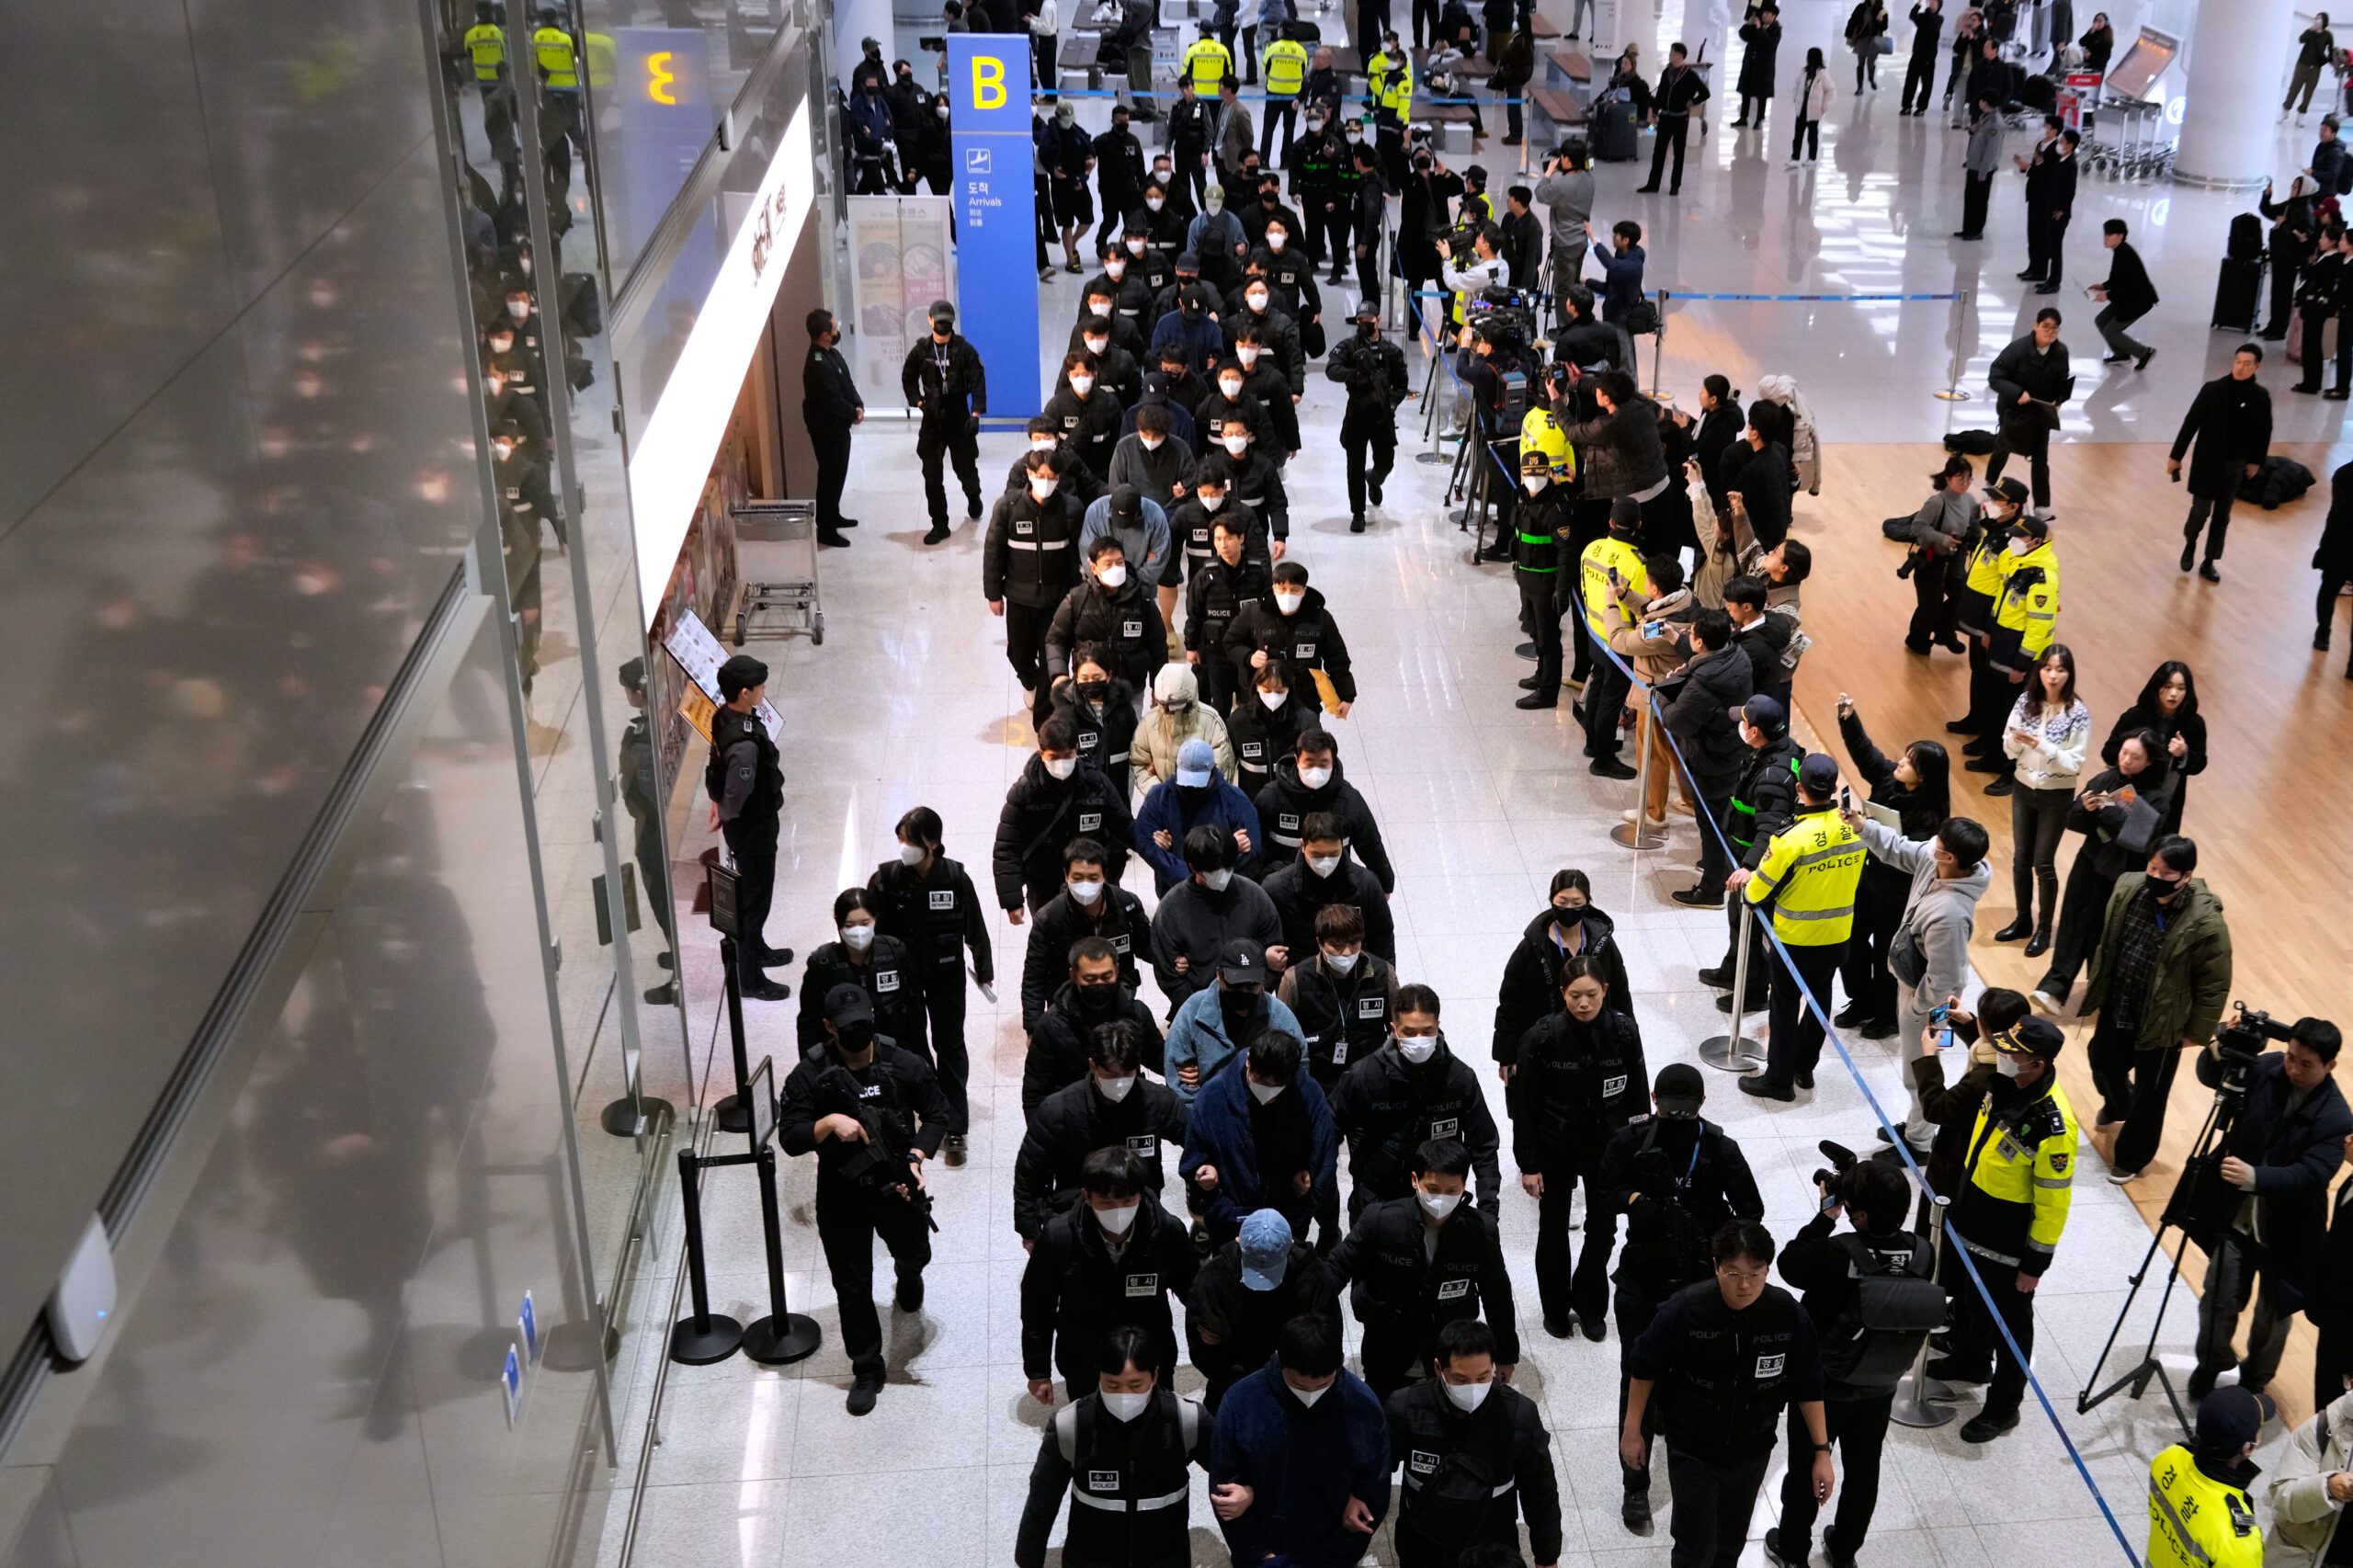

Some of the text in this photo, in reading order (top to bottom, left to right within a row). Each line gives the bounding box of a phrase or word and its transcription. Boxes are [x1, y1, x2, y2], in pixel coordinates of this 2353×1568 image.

[972, 56, 1007, 109] B
[968, 182, 989, 196] 도착
[969, 197, 1002, 207] Arrivals
[1813, 824, 1852, 847] 경찰
[1807, 854, 1860, 876] POLICE
[1130, 1276, 1155, 1287] 형사
[1441, 1289, 1464, 1298] POLICE
[1688, 1329, 1722, 1339] POLIC
[1754, 1332, 1792, 1345] POLICE
[1415, 1453, 1437, 1465] 수사
[1092, 1472, 1116, 1482] 수사
[2149, 1500, 2190, 1567] OLICE
